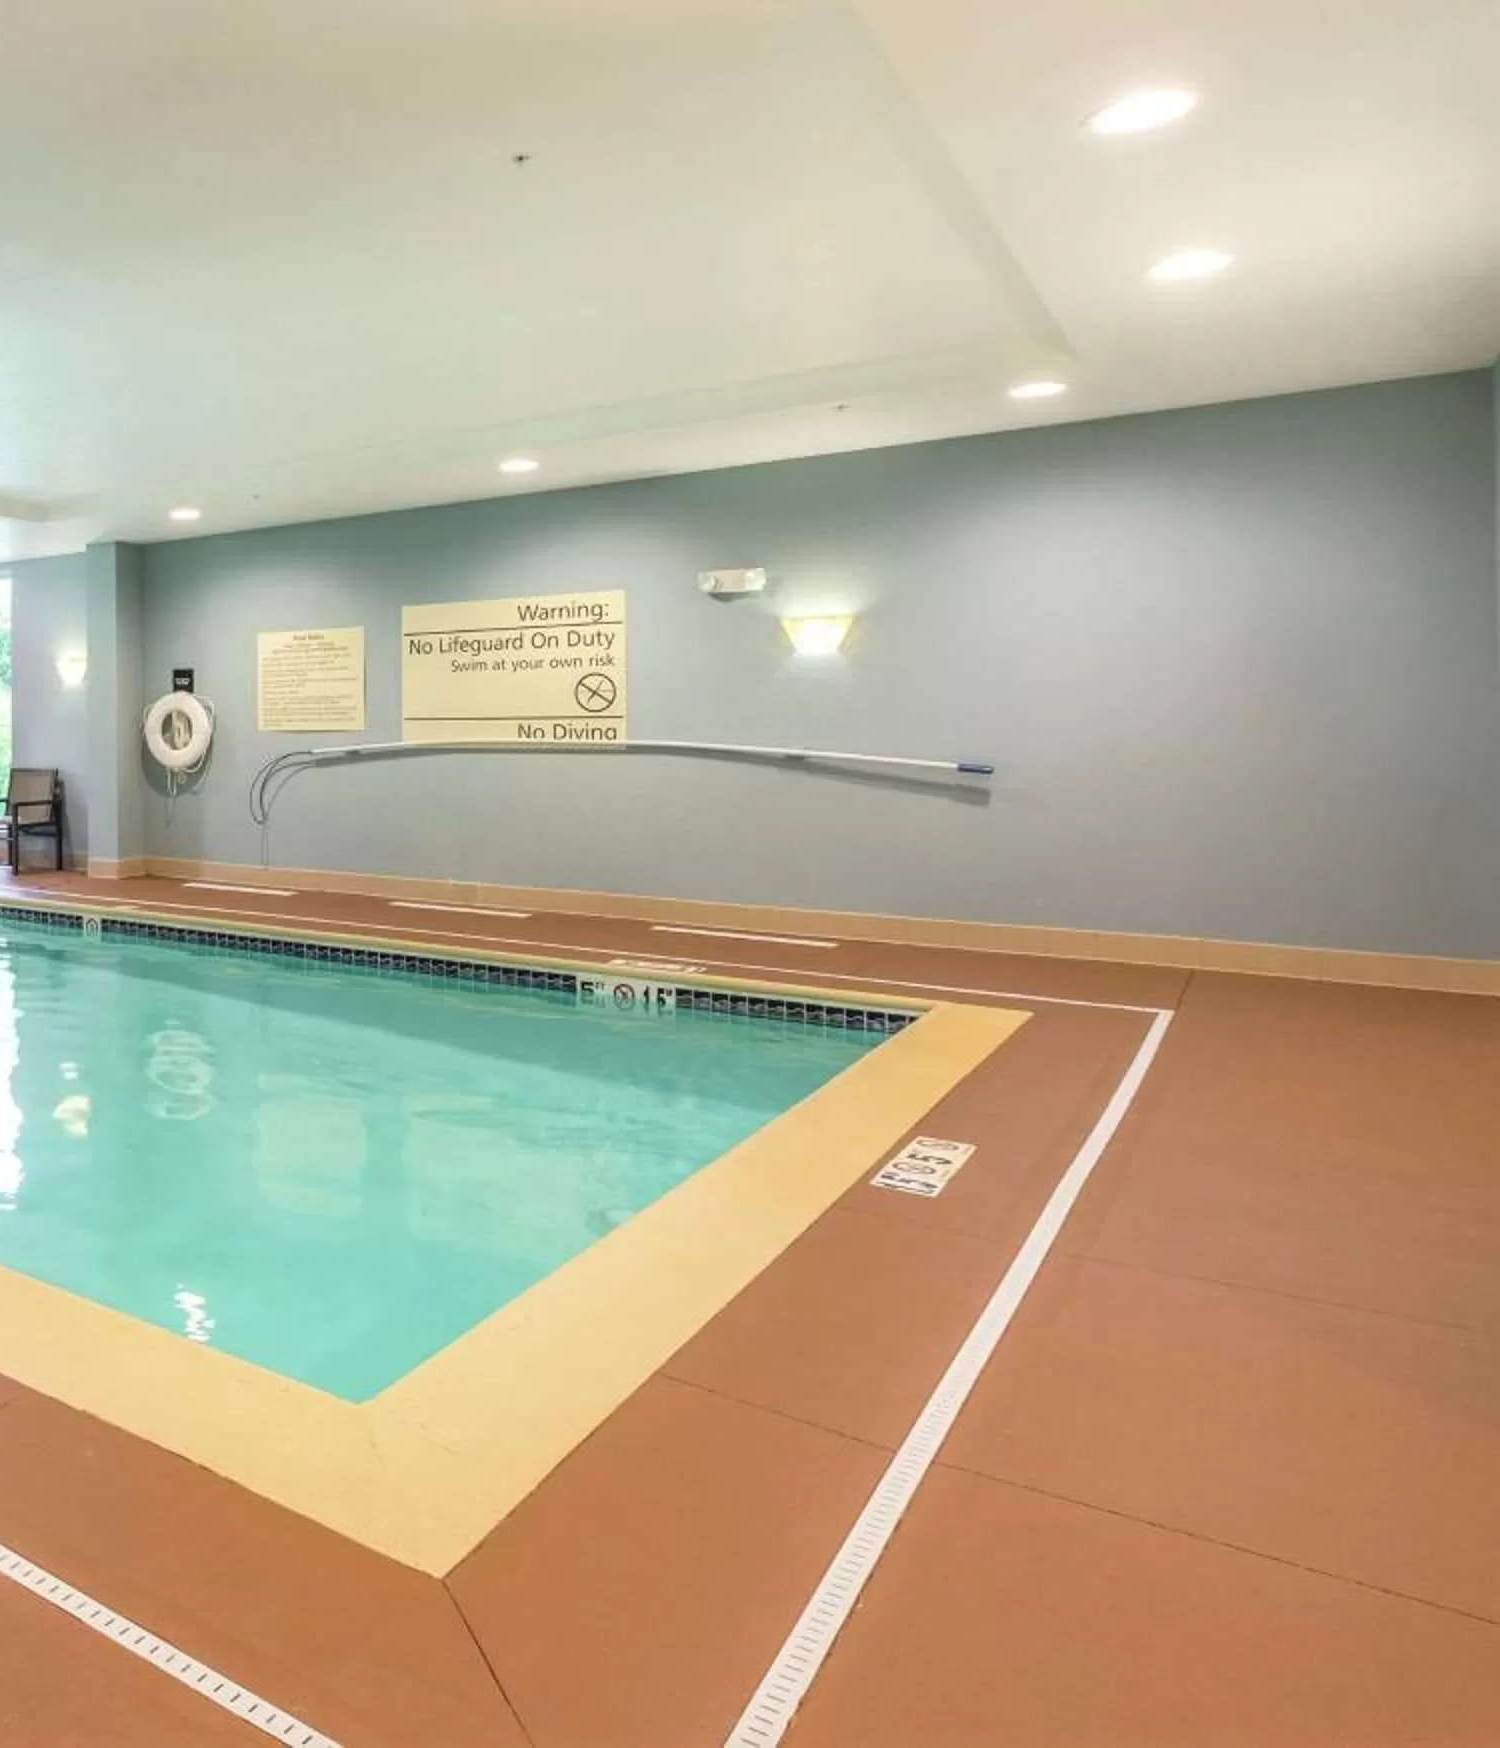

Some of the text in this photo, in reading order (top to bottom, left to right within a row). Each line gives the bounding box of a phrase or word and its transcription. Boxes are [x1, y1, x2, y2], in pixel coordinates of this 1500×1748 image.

[517, 603, 609, 622] Warning:
[408, 630, 616, 657] No Lifeguard On Duty
[451, 653, 616, 673] Swim at your own risk
[517, 723, 545, 739] No
